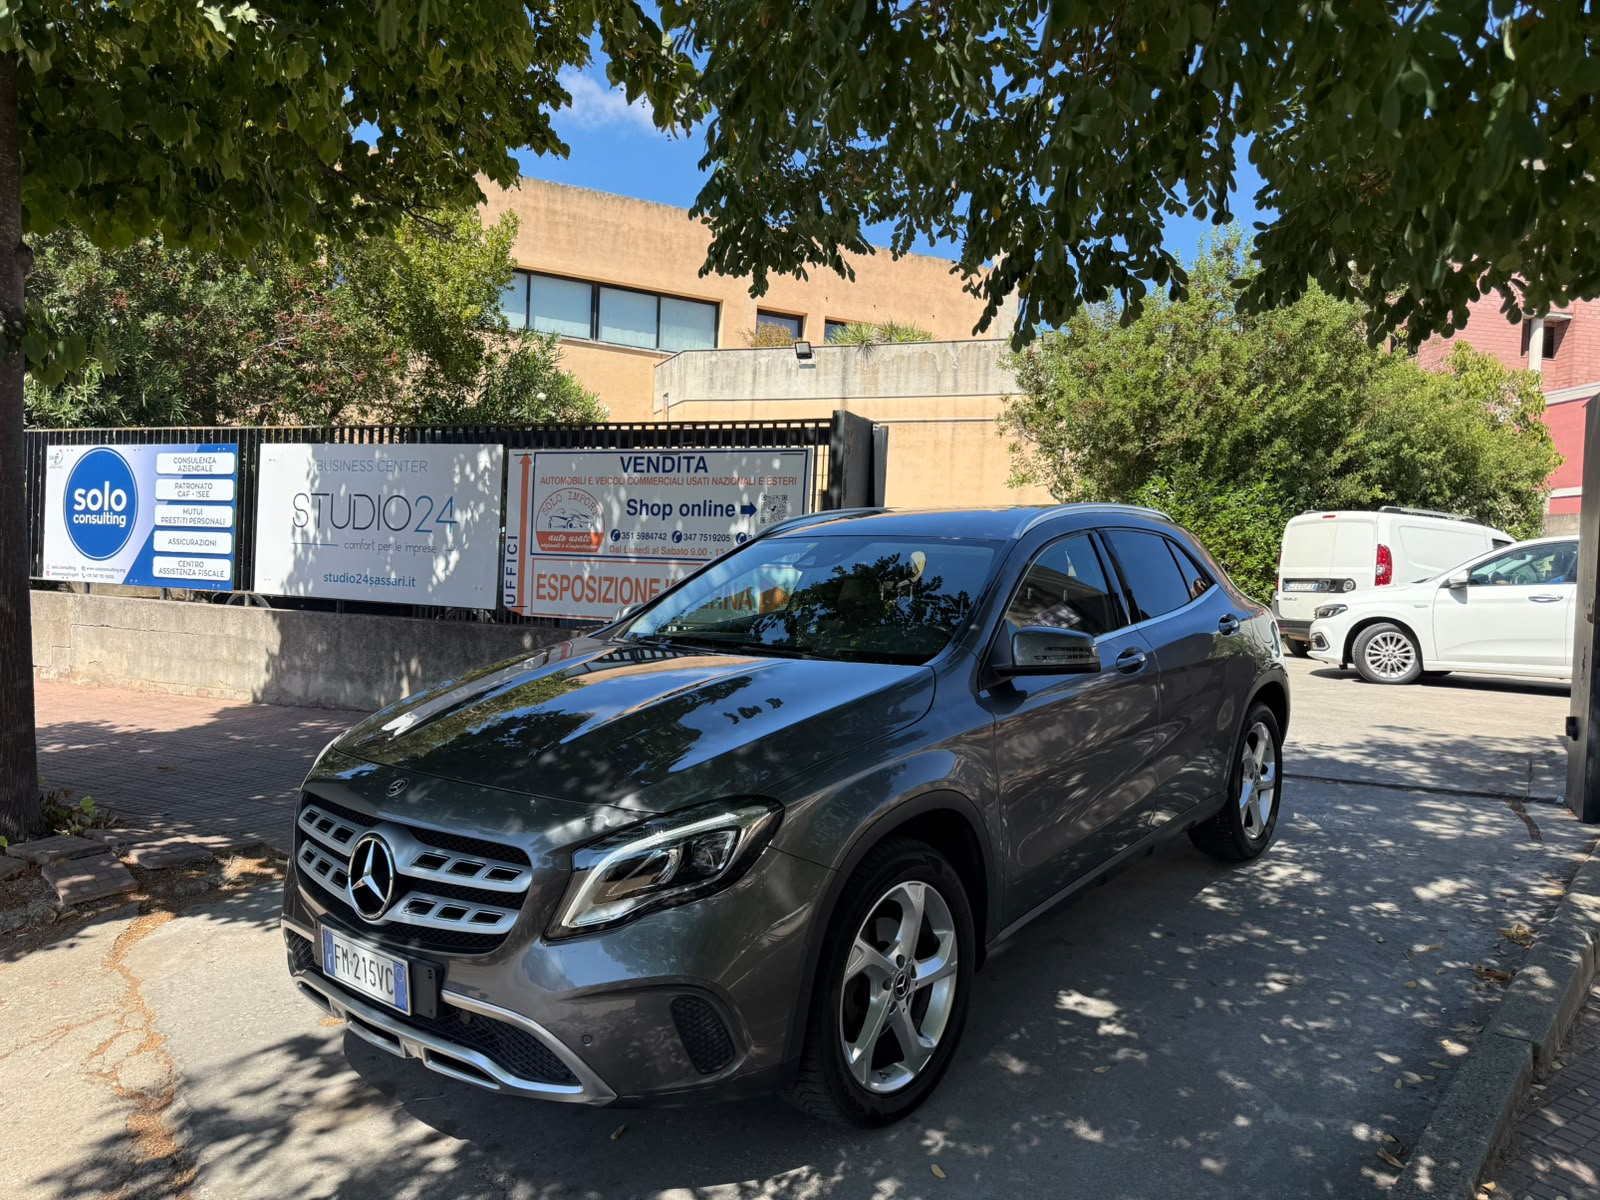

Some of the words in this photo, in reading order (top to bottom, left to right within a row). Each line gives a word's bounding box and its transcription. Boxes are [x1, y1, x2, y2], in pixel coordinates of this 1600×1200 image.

[173, 456, 217, 464] CONSULENZA
[316, 459, 374, 473] BUSINESS
[376, 459, 428, 473] CENTER
[620, 455, 709, 474] VENDITA
[174, 482, 213, 490] PATRONATO
[540, 476, 587, 485] AUTOMOBILI
[588, 476, 594, 485] E
[595, 476, 625, 485] VEICOLI
[627, 476, 683, 486] COMMERCIALI
[686, 476, 710, 486] USATI
[711, 476, 755, 486] NAZIONALI
[758, 477, 765, 486] E
[767, 477, 797, 486] ESTERI
[73, 480, 127, 512] solo
[542, 493, 563, 516] SOLO
[626, 498, 673, 521] Shop
[679, 499, 736, 518] online
[73, 512, 127, 528] consulting
[292, 492, 458, 534] STUDIO24
[160, 516, 188, 524] PRESTITI
[189, 517, 226, 525] PERSONALI
[168, 537, 217, 546] ASSICURAZIONI
[548, 534, 566, 542] auto
[621, 531, 634, 540] 351
[636, 531, 667, 541] 5984742
[683, 533, 697, 542] 347
[699, 533, 731, 542] 7519205
[344, 538, 375, 551] comfort
[377, 543, 391, 556] per
[394, 541, 402, 551] le
[404, 542, 438, 556] imprese
[609, 544, 622, 553] Dal
[661, 545, 688, 556] Sabato
[690, 547, 707, 557] 9.00
[177, 560, 205, 568] CENTRO
[505, 535, 518, 605] UFFICI
[158, 567, 197, 576] ASSISTENZA
[197, 569, 225, 578] FISCALE
[323, 571, 417, 588] studio24sassari.it
[536, 573, 662, 606] ESPOSIZIONE
